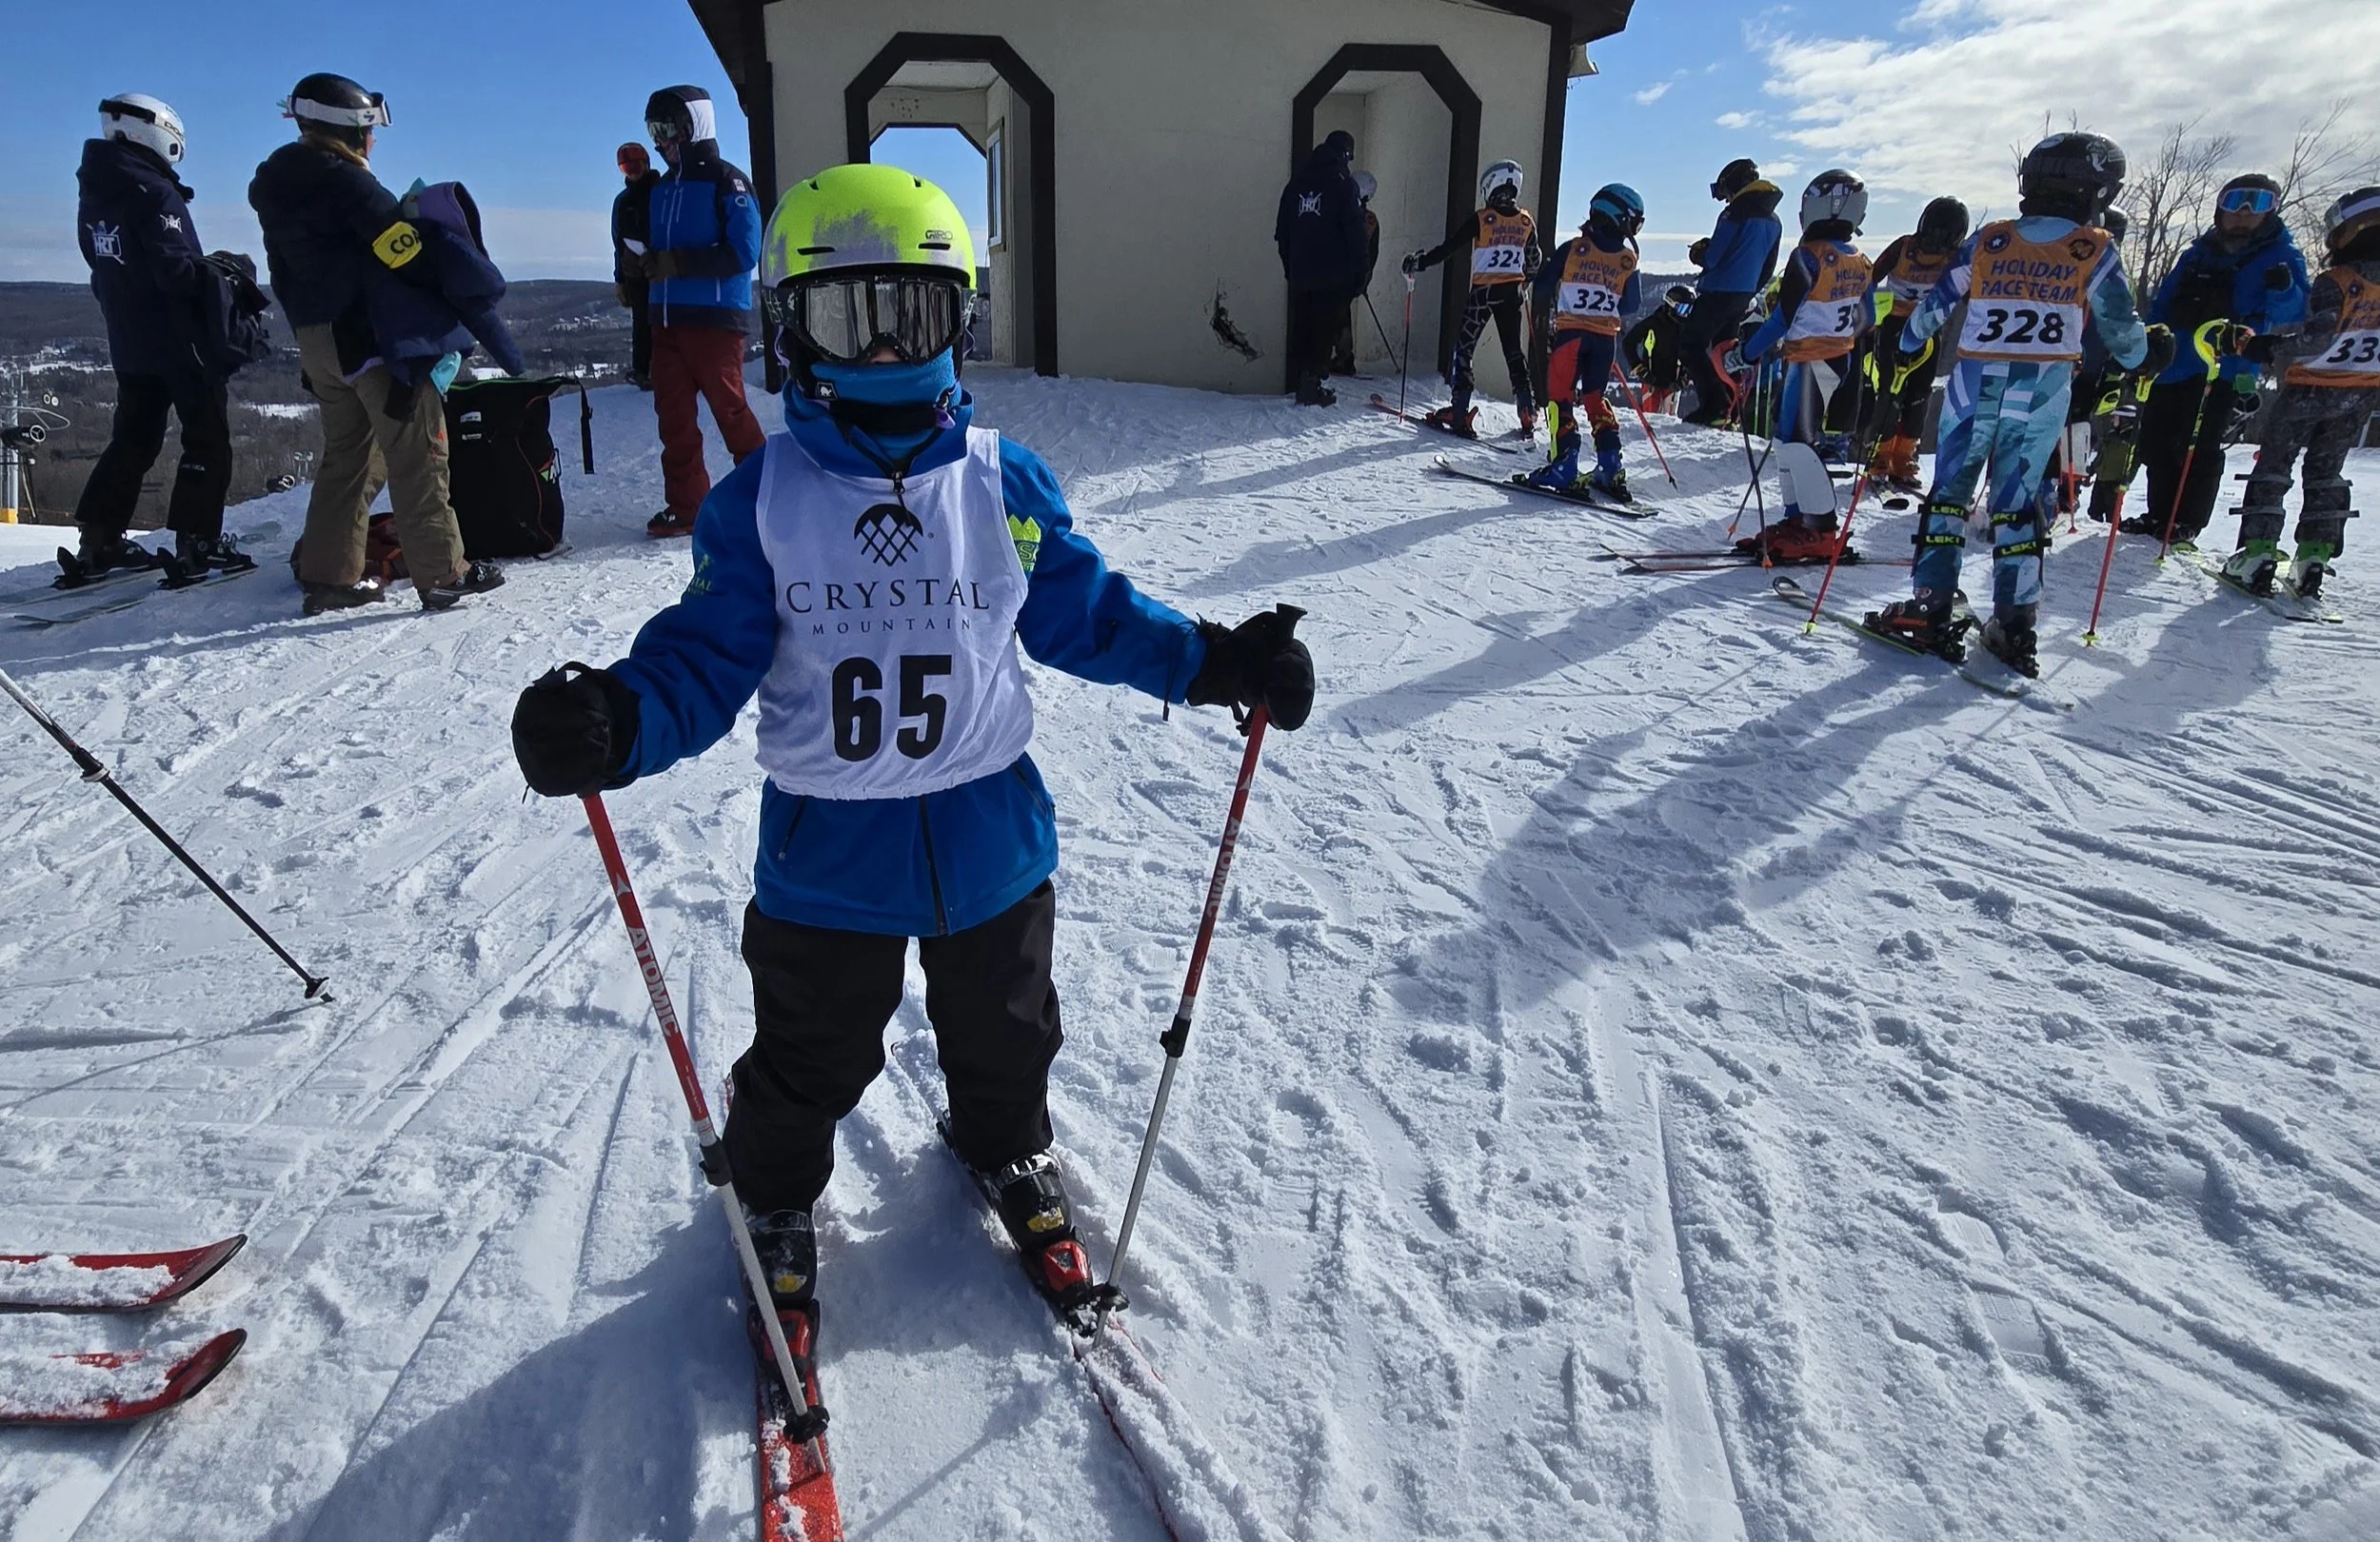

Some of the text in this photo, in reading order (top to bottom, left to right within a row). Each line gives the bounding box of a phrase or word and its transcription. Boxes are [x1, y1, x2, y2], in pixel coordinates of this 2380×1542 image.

[925, 229, 953, 240] GIRO
[1573, 272, 1601, 284] RACE
[1991, 259, 2078, 281] HOLIDAY
[1981, 280, 2079, 301] RACE TEAM
[1976, 308, 2065, 344] 328
[2326, 337, 2380, 363] 33
[1931, 505, 1964, 515] LEKI
[1992, 513, 2017, 523] EKI
[1926, 535, 1959, 544] LEKI
[2001, 541, 2036, 556] LEKI
[785, 579, 989, 613] CRYSTAL
[812, 618, 971, 636] MOUNTAIN
[832, 654, 952, 761] 65
[1207, 817, 1240, 918] ATOMIC
[627, 927, 681, 1038] ATOMIC
